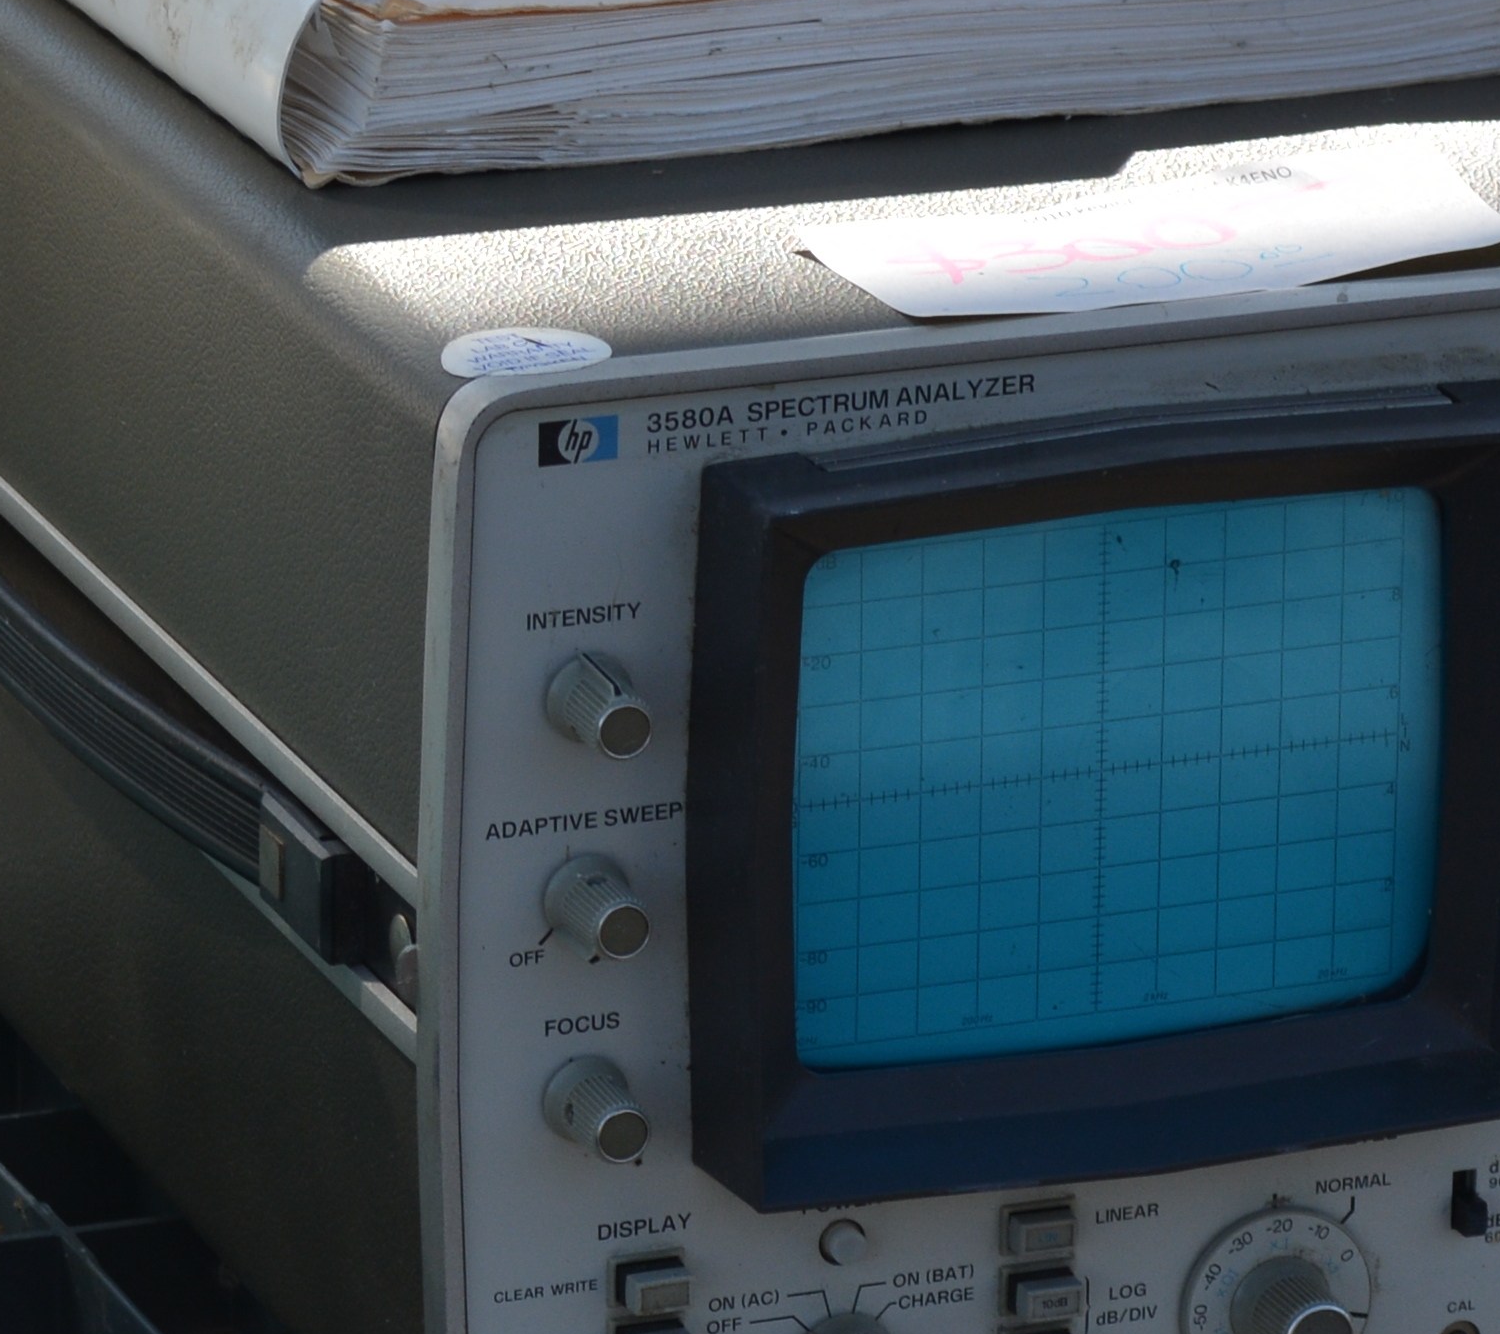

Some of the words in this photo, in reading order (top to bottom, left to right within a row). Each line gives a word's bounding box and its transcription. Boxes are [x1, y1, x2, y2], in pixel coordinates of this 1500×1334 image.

[646, 406, 734, 433] 3580A
[747, 390, 889, 424] SPECTRUM
[896, 373, 1035, 407] ANALYZER
[647, 427, 768, 454] HEWLETT
[807, 410, 928, 436] PACKARD
[527, 603, 641, 632] INTENSITY
[486, 812, 598, 841] ADAPTIVE
[604, 801, 683, 827] SWEEP
[509, 949, 545, 968] OFF
[544, 1012, 620, 1037] FOCUS
[1315, 1172, 1391, 1195] NORMAL
[1095, 1203, 1160, 1224] LINEAR
[598, 1214, 692, 1242] DISPLAY
[893, 1272, 919, 1289] ON
[925, 1264, 975, 1286] (BAT)
[494, 1287, 545, 1304] CLEAR
[550, 1279, 599, 1298] WRITE
[708, 1296, 736, 1312] ON
[741, 1289, 780, 1310] (AC)
[898, 1286, 975, 1310] CHARGE
[1109, 1283, 1147, 1300] LOG
[1096, 1305, 1157, 1327] dB/DIV
[1447, 1299, 1476, 1313] CAL
[707, 1317, 743, 1334] OFF
